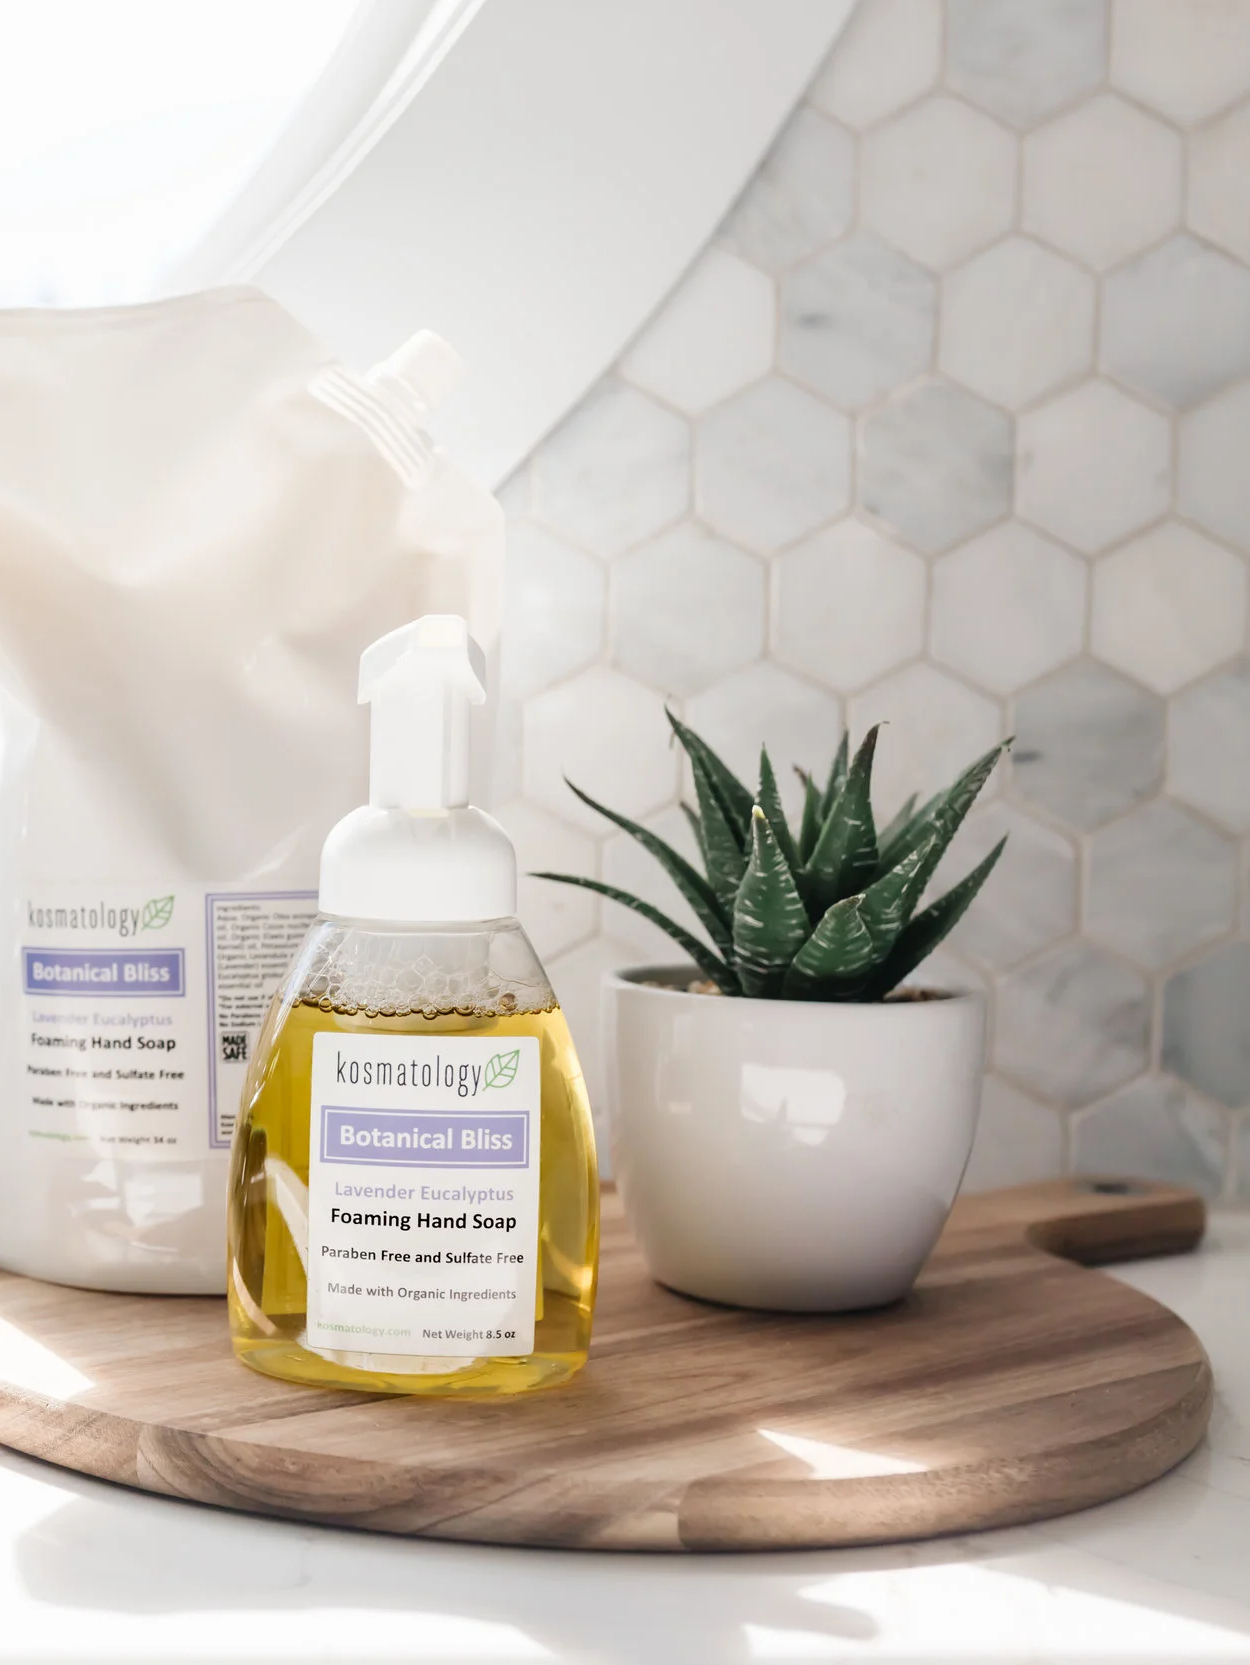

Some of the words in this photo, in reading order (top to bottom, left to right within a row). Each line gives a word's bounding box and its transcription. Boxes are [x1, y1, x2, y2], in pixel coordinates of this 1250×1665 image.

[29, 901, 139, 937] kosmatology
[33, 962, 117, 981] Botanical
[124, 964, 170, 982] Bliss
[32, 1012, 88, 1025] Lavender
[93, 1014, 173, 1028] Eucalyptus
[31, 1033, 86, 1051] Foaming
[92, 1037, 131, 1049] Hand
[137, 1037, 176, 1052] Soap
[222, 1034, 247, 1046] MADE
[223, 1047, 247, 1060] SAFE
[27, 1065, 61, 1077] Paraben
[92, 1070, 111, 1079] and
[116, 1070, 155, 1080] Sulfate
[159, 1070, 184, 1080] Free
[337, 1051, 481, 1097] kosmatology
[120, 1101, 179, 1112] Ingredients
[340, 1125, 453, 1149] Botanical
[461, 1129, 513, 1150] Bliss
[335, 1182, 415, 1199] Lavender
[421, 1186, 514, 1205] Eucalyptus
[331, 1208, 411, 1231] Foaming
[417, 1213, 467, 1229] Hand
[472, 1214, 517, 1232] Soap
[321, 1246, 376, 1260] Paraben
[381, 1250, 411, 1262] Free
[415, 1252, 441, 1263] and
[446, 1252, 492, 1264] Sulfate
[497, 1253, 524, 1264] Free
[327, 1282, 363, 1296] Made
[366, 1286, 394, 1298] with
[397, 1287, 445, 1300] Organic
[449, 1289, 516, 1302] Ingredients
[316, 1320, 412, 1337] kosmatology.com
[422, 1329, 442, 1339] Net
[445, 1329, 484, 1341] Weight
[486, 1329, 502, 1339] 8.5
[504, 1331, 516, 1339] oz
